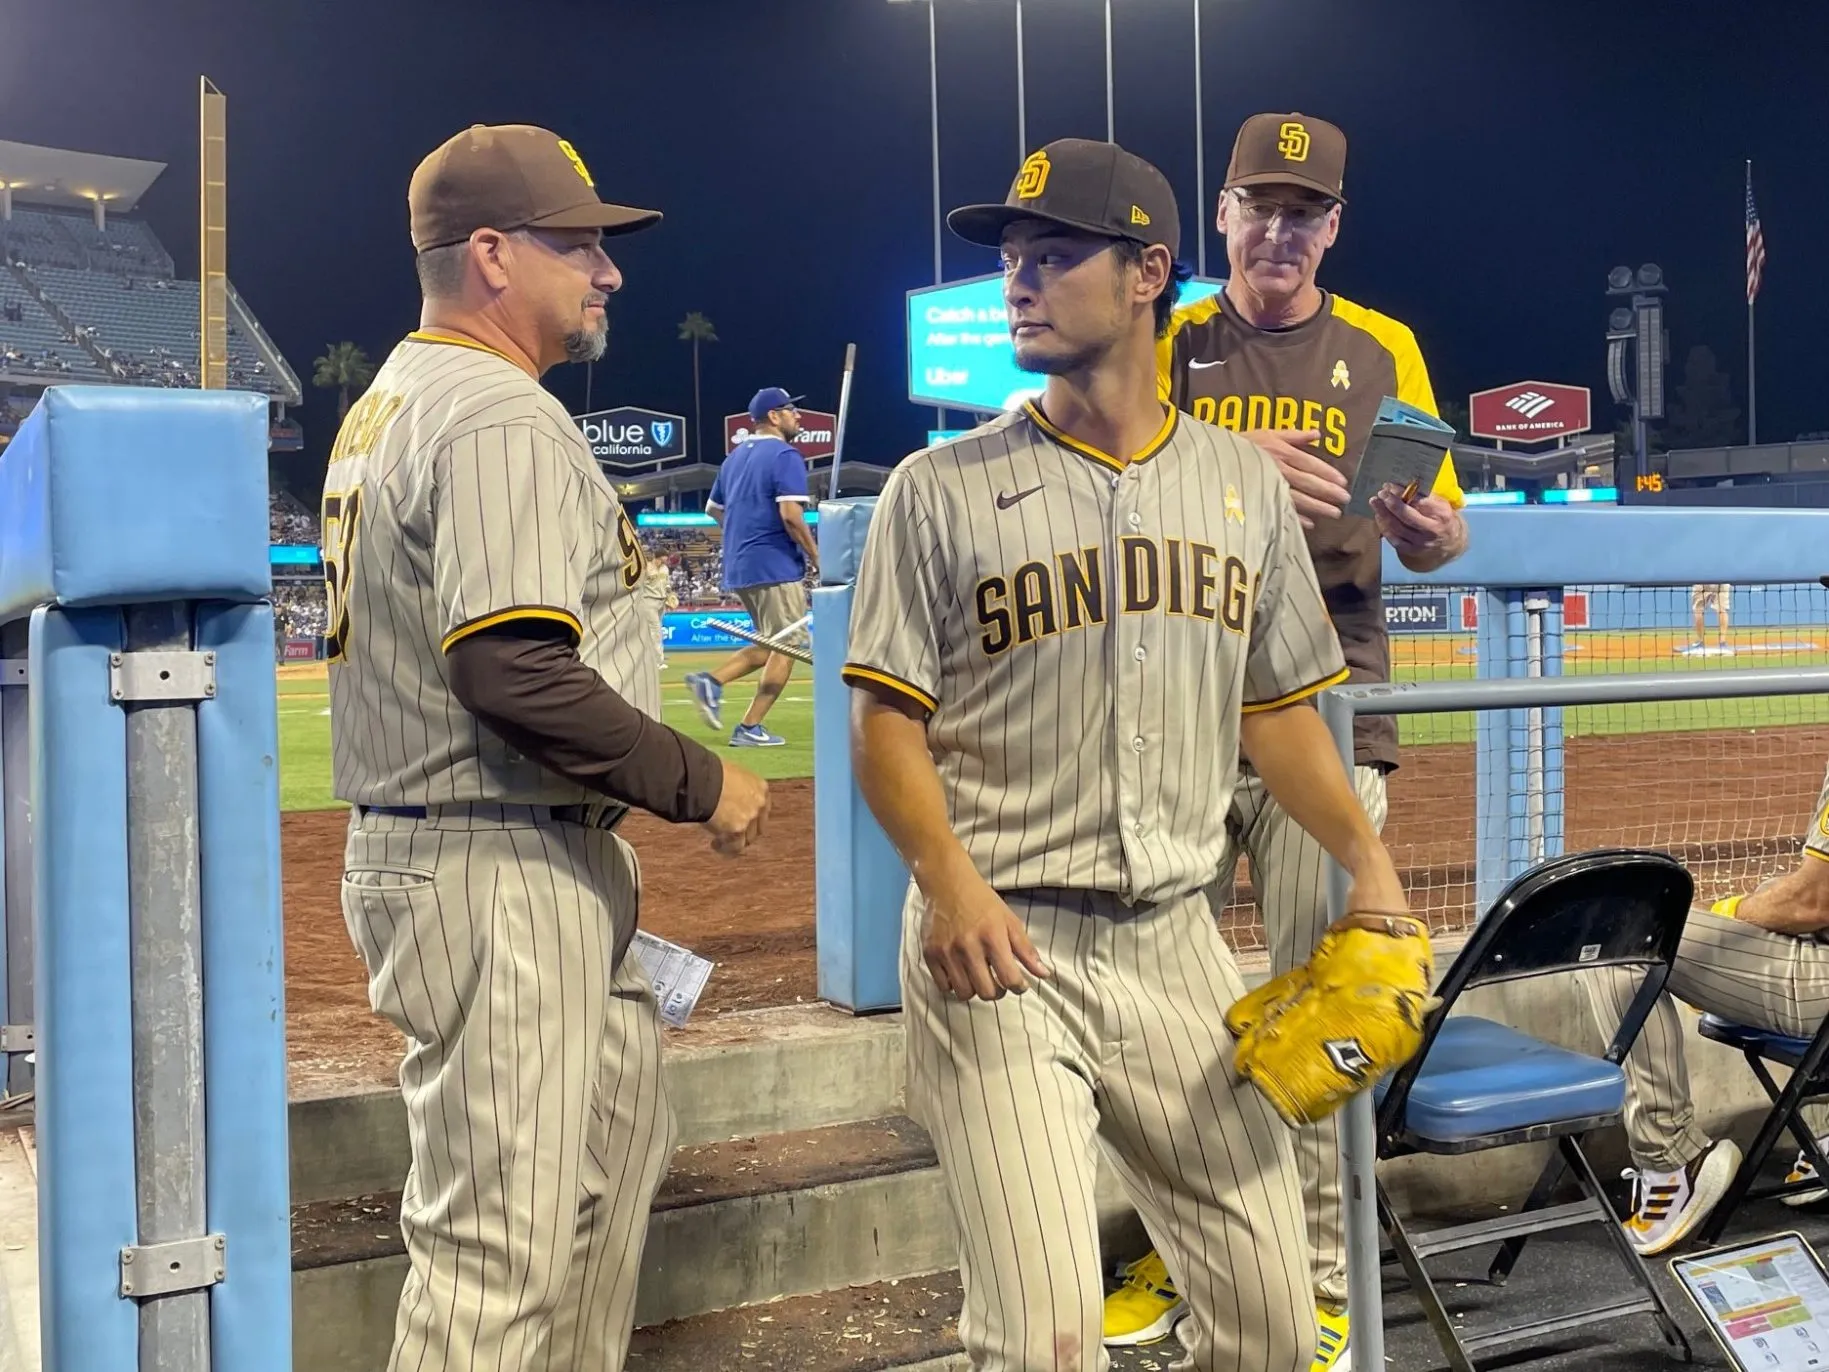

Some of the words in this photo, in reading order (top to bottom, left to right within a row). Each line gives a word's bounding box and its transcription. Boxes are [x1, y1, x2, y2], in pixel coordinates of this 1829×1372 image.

[1278, 122, 1310, 162] SD
[1016, 150, 1051, 200] SD
[925, 366, 970, 387] Uber
[582, 418, 645, 444] blue
[1193, 394, 1347, 458] PADRES
[1529, 421, 1565, 429] AMERICA
[592, 443, 652, 456] california
[974, 545, 1108, 658] SAN
[1118, 534, 1263, 639] DIEG
